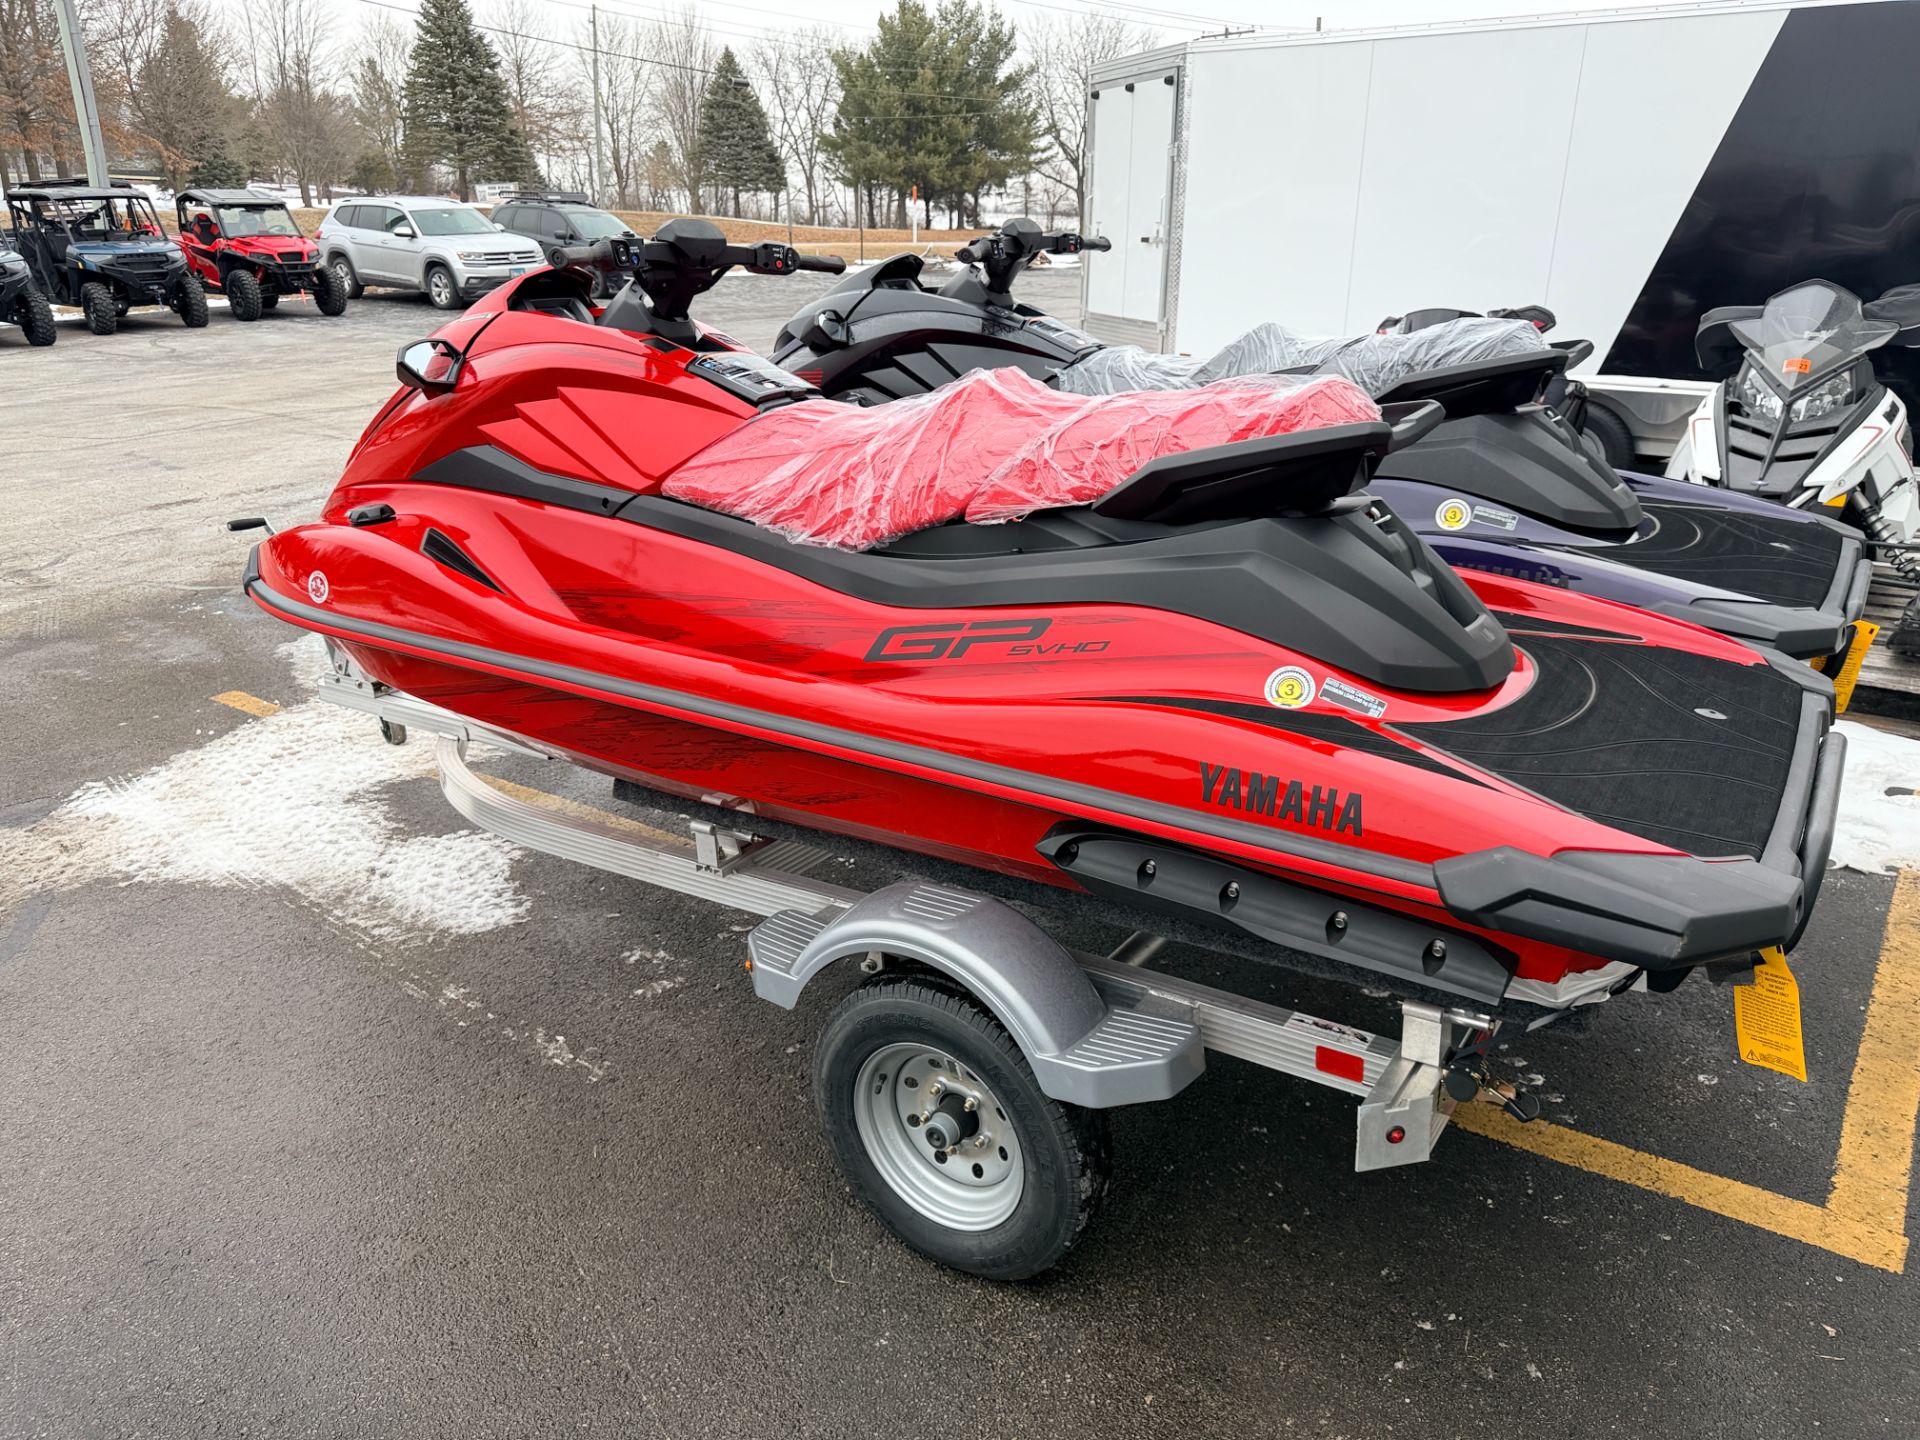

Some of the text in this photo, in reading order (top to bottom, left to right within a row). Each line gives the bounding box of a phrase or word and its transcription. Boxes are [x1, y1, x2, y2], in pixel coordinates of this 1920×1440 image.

[1450, 511, 1457, 519] 3
[863, 618, 1053, 662] GP
[1284, 683, 1295, 696] 3
[1200, 761, 1363, 837] YAMAHA
